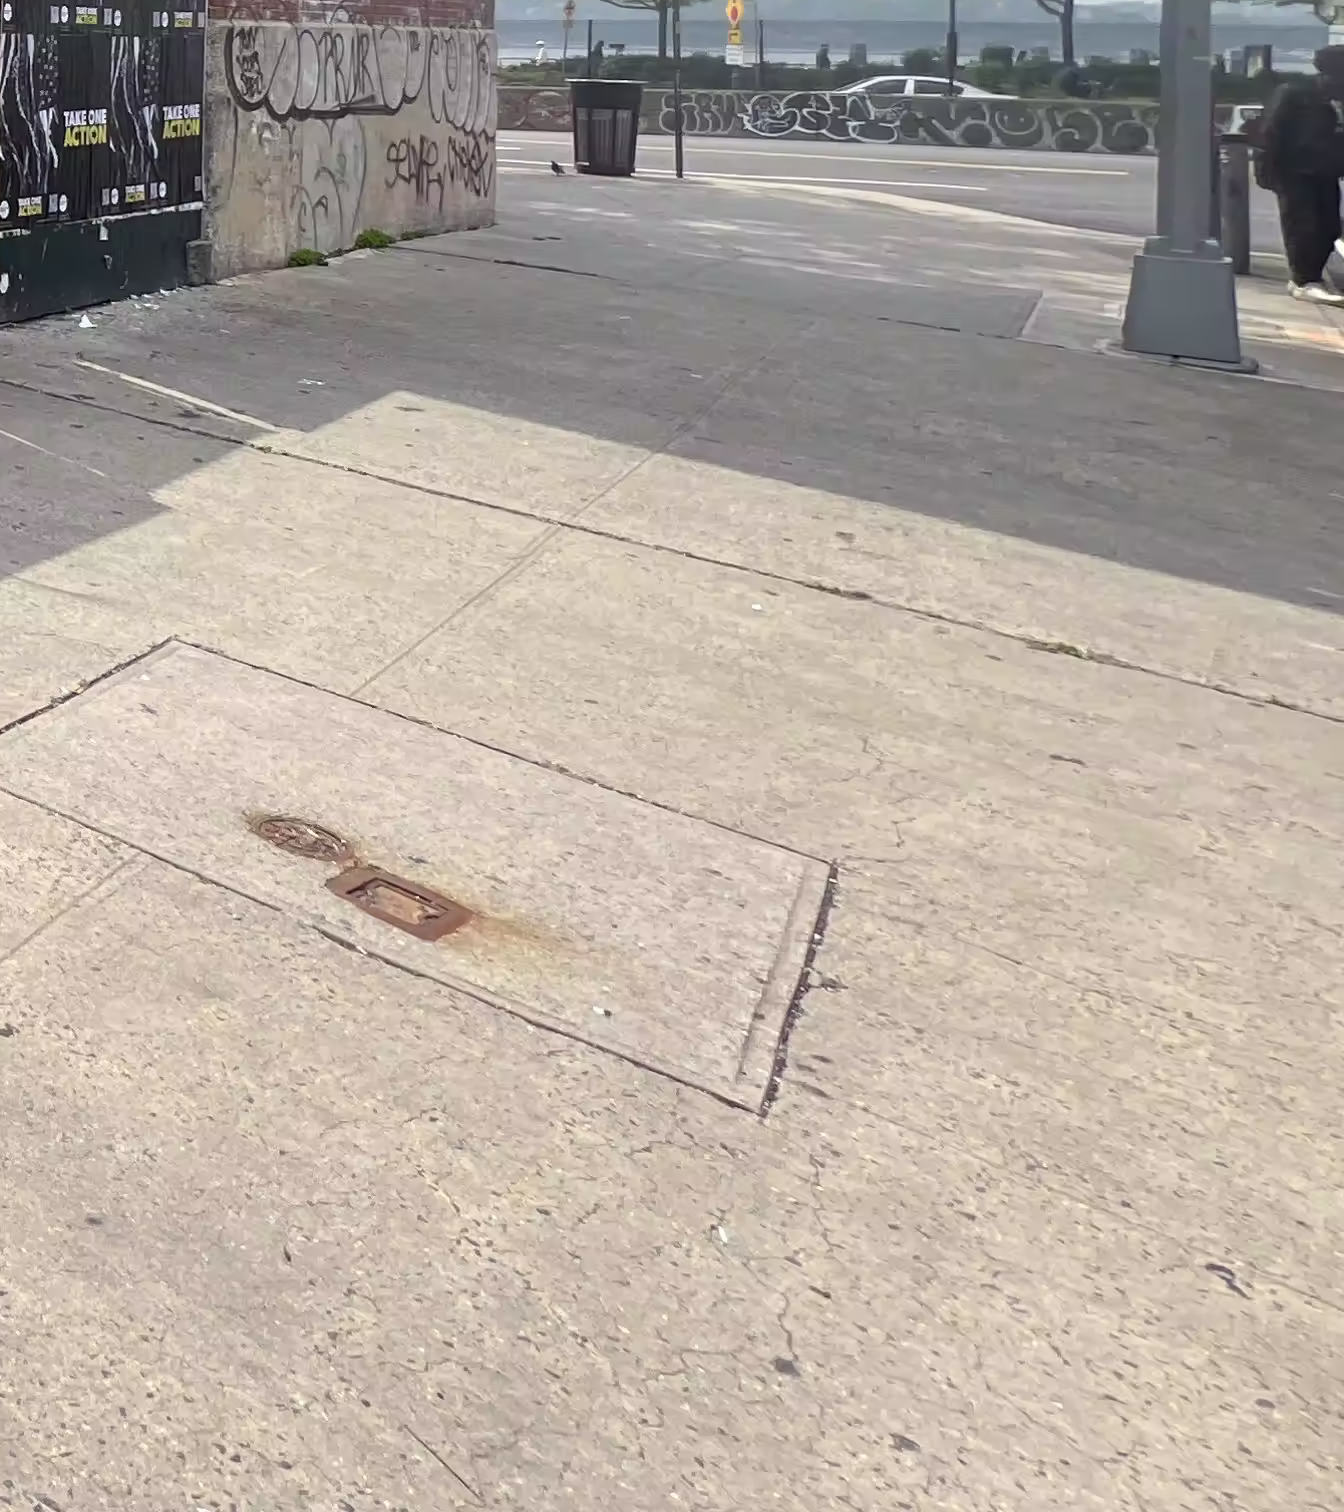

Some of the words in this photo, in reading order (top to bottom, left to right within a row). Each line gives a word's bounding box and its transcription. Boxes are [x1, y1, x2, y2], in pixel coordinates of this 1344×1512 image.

[63, 109, 87, 127] TAKE
[88, 108, 107, 125] ONE
[162, 105, 182, 120] TAKE
[183, 103, 200, 118] ONE
[63, 124, 107, 147] ACTION
[162, 118, 200, 139] ACTION
